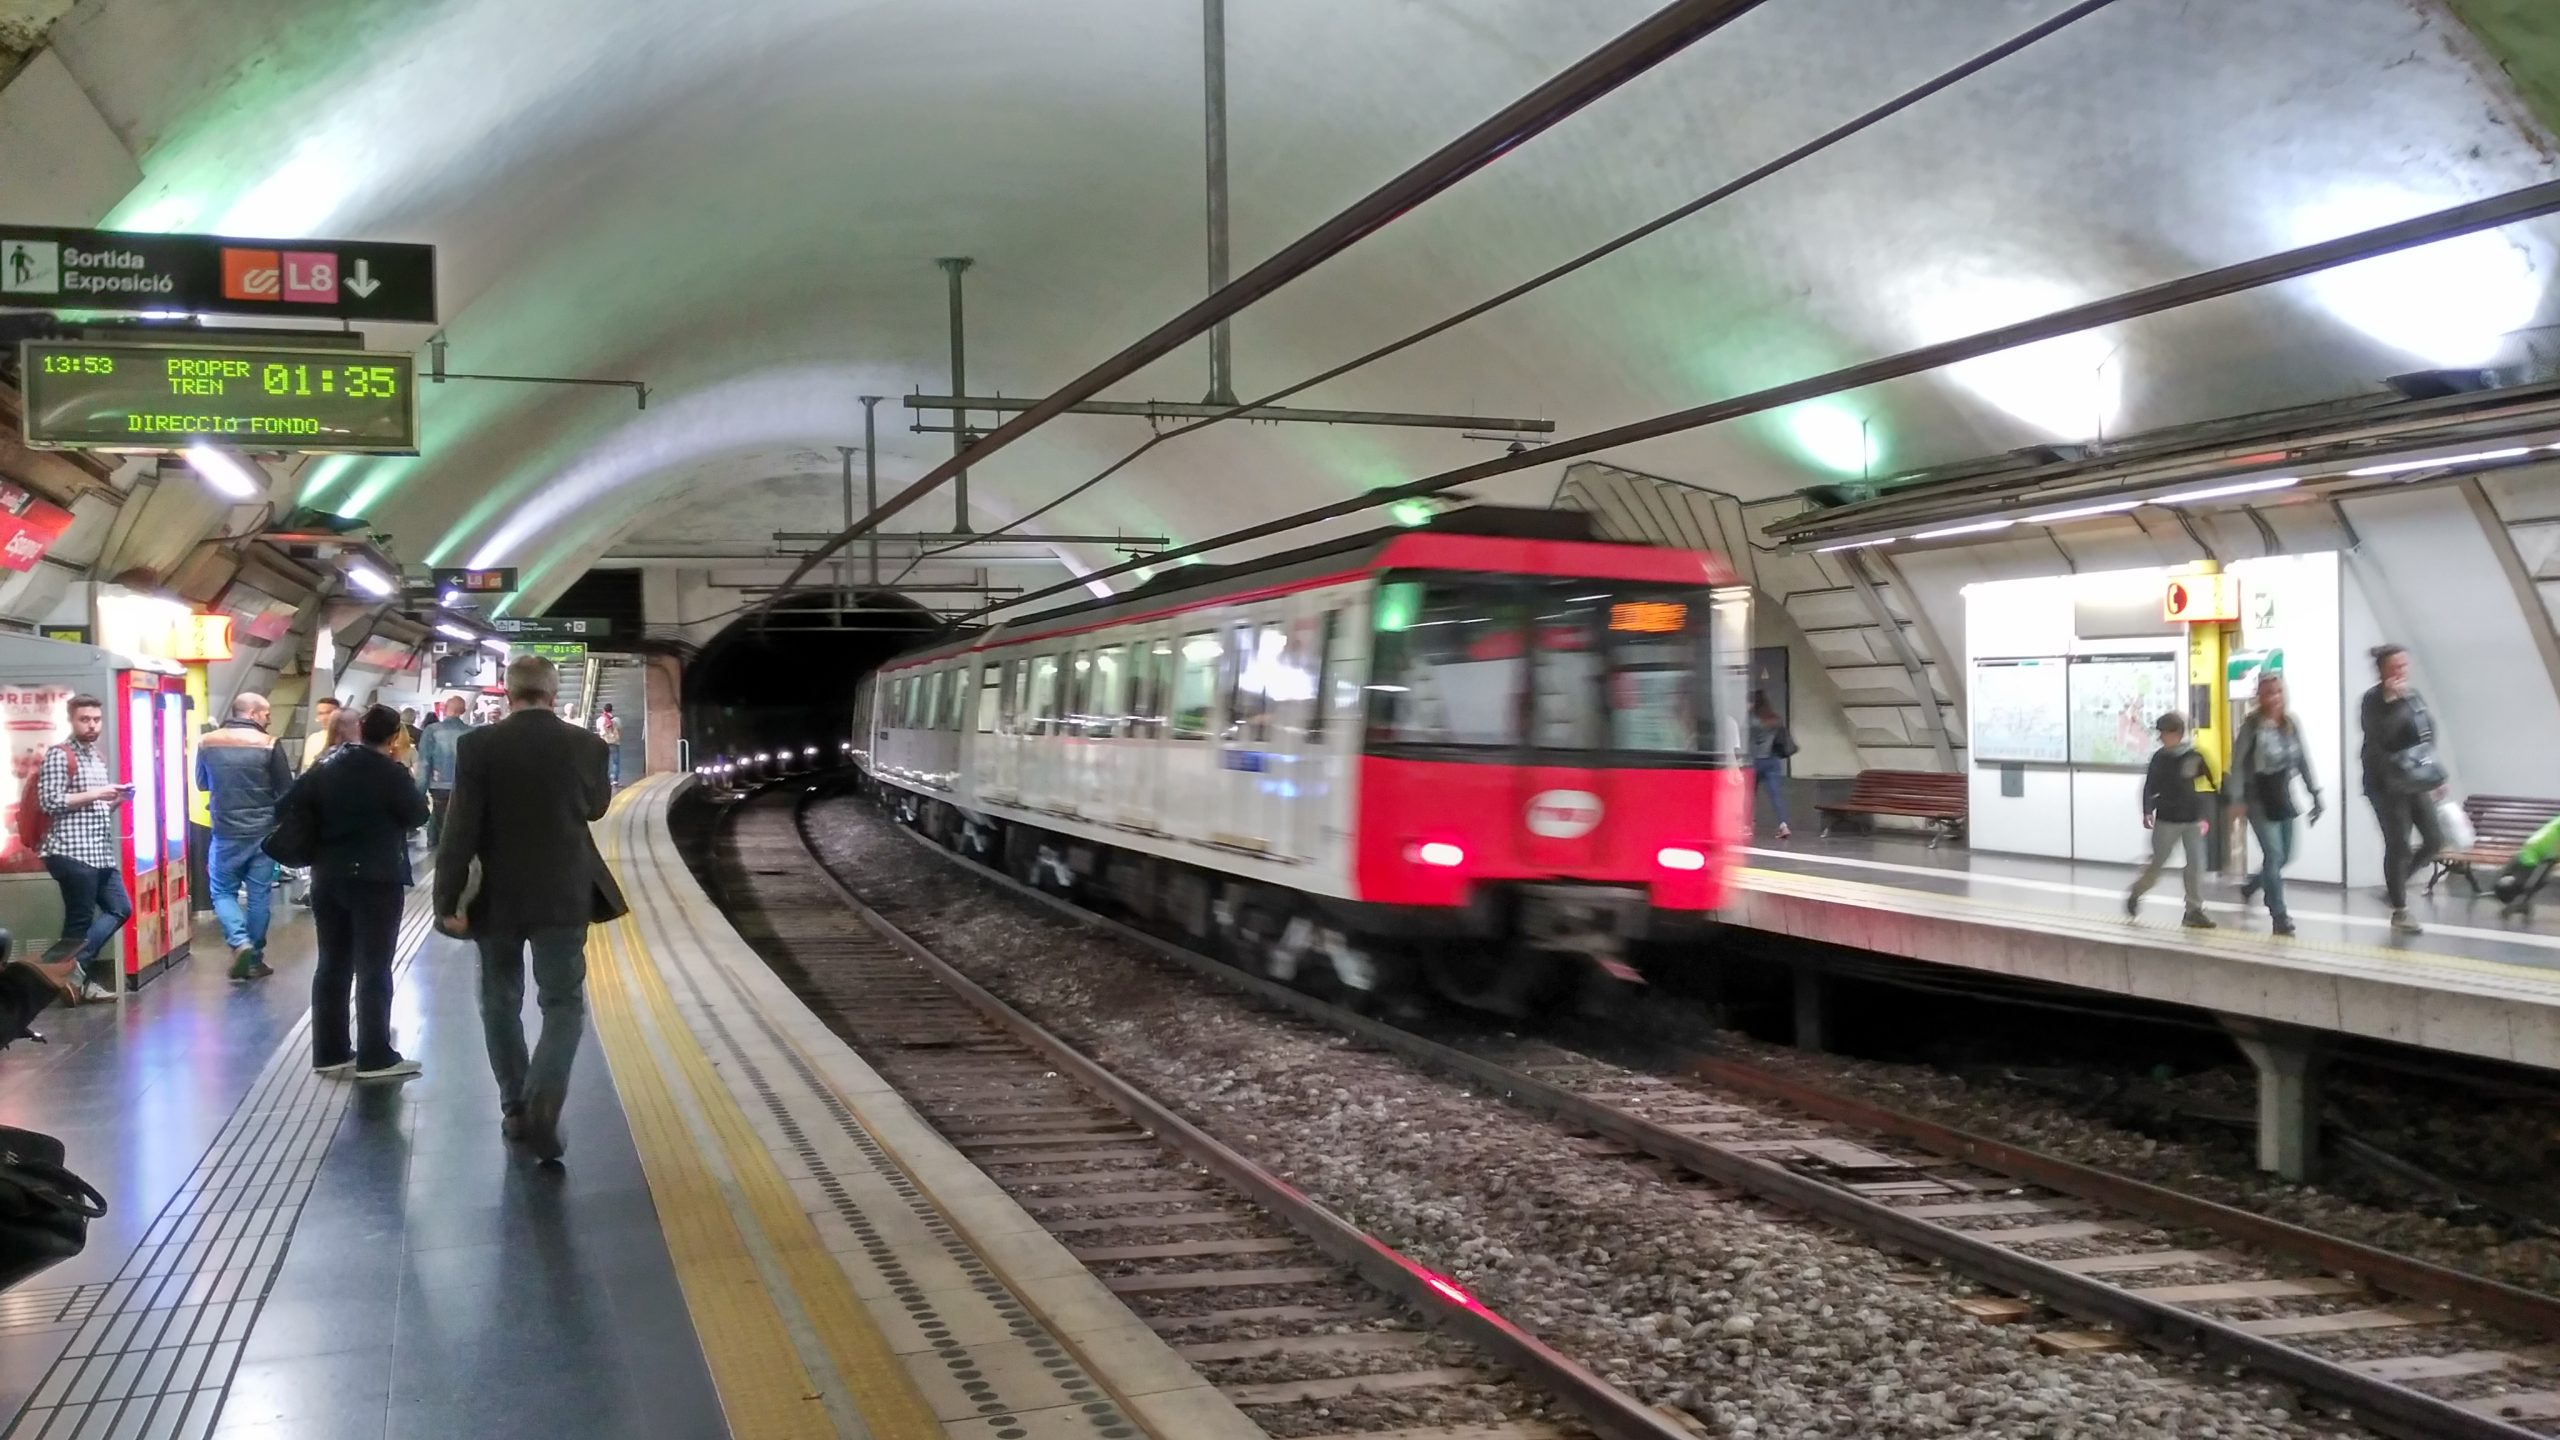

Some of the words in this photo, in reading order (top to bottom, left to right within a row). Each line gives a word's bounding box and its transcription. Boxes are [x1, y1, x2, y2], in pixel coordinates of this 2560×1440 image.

[63, 247, 145, 270] Sortida
[64, 271, 173, 294] Exposició
[288, 263, 333, 292] L8
[43, 355, 113, 374] 13:53
[167, 359, 250, 377] PROPER
[168, 378, 223, 395] TREN
[263, 364, 395, 398] 01:35
[251, 417, 319, 434] FONDO
